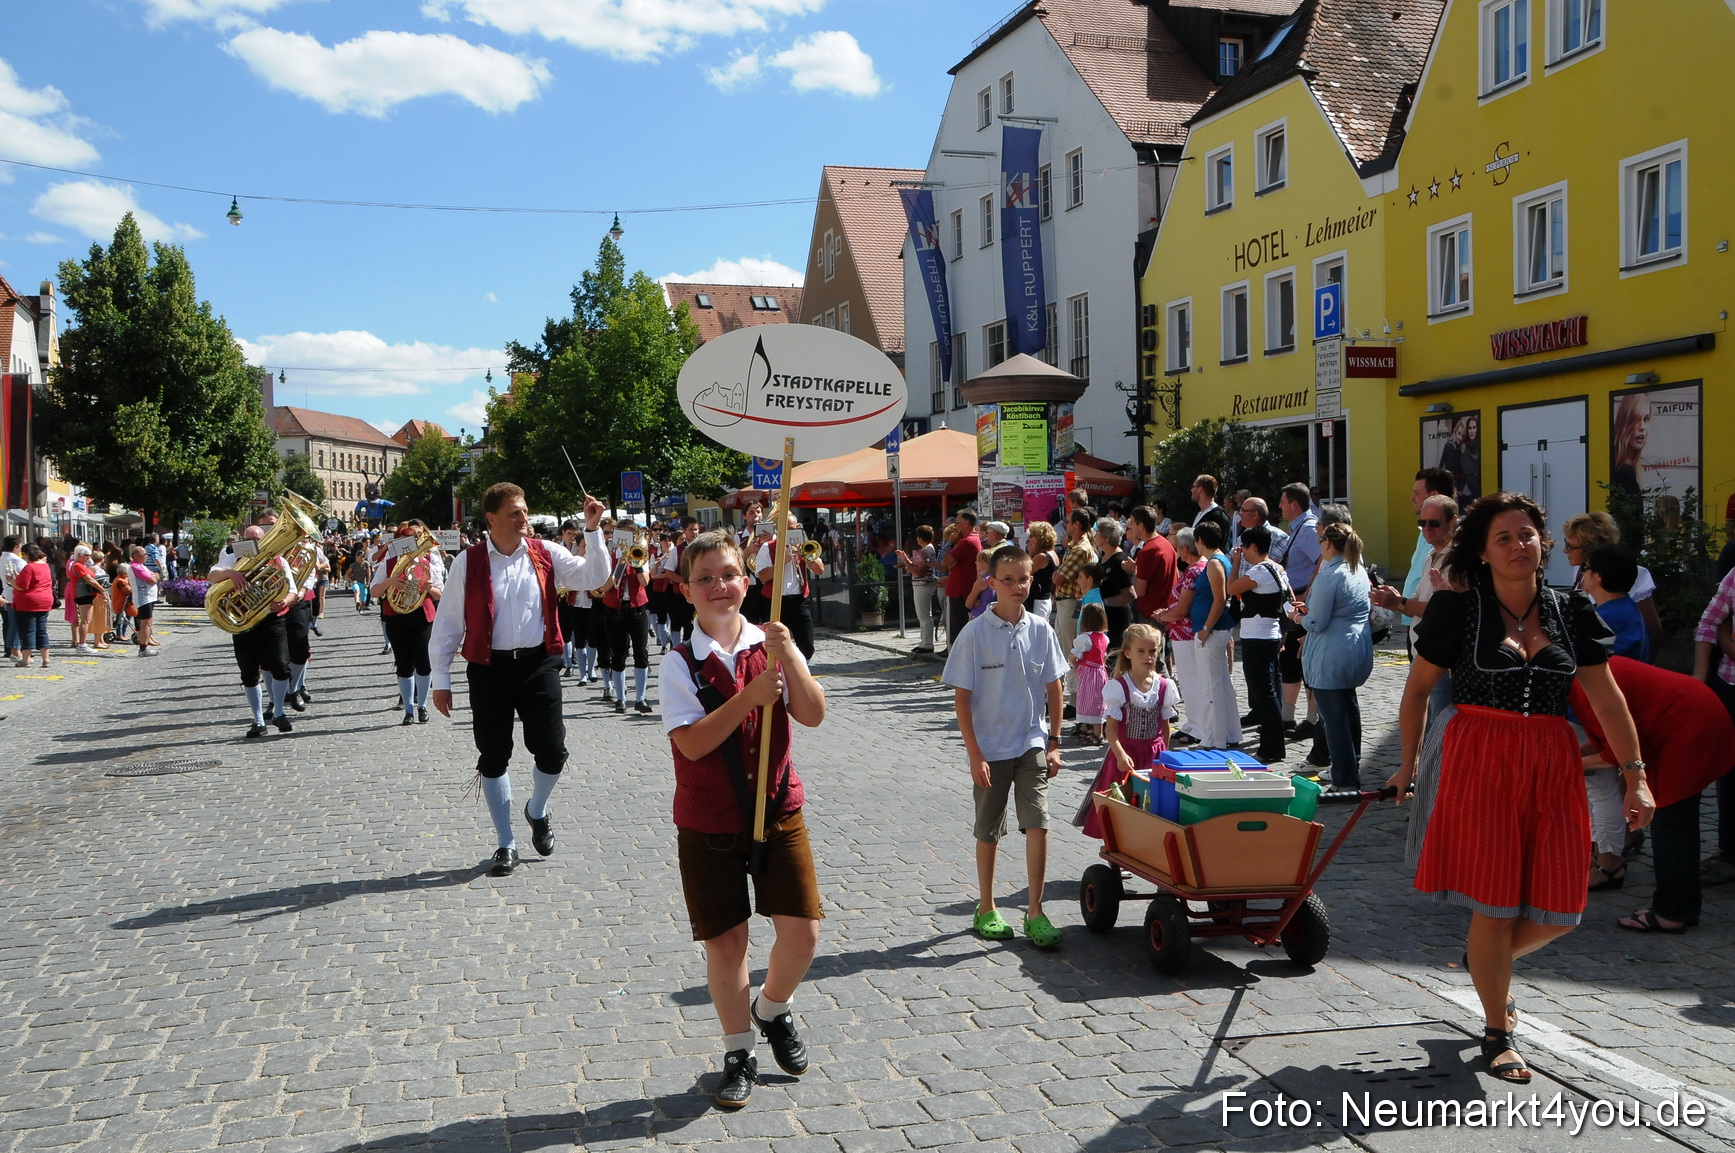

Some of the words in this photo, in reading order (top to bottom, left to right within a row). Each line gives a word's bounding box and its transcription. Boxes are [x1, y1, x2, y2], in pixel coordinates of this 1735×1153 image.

[1487, 155, 1517, 171] SUPERIOR
[1234, 229, 1289, 272] HOTEL
[1304, 206, 1377, 248] Lehmeier
[1019, 216, 1036, 296] RUPPERT
[1026, 300, 1038, 332] K&L
[1320, 292, 1334, 331] P
[1490, 315, 1588, 360] WISSMACH
[1317, 351, 1339, 360] Parkschein
[1319, 360, 1338, 368] werktags
[1349, 356, 1394, 368] WISSMACH
[773, 374, 892, 396] STADTKAPELLE
[766, 393, 854, 413] FREYSTADT
[1003, 405, 1044, 413] Jacobikirwa
[1232, 387, 1309, 416] Restaurant
[1656, 402, 1693, 414] TAIFUN
